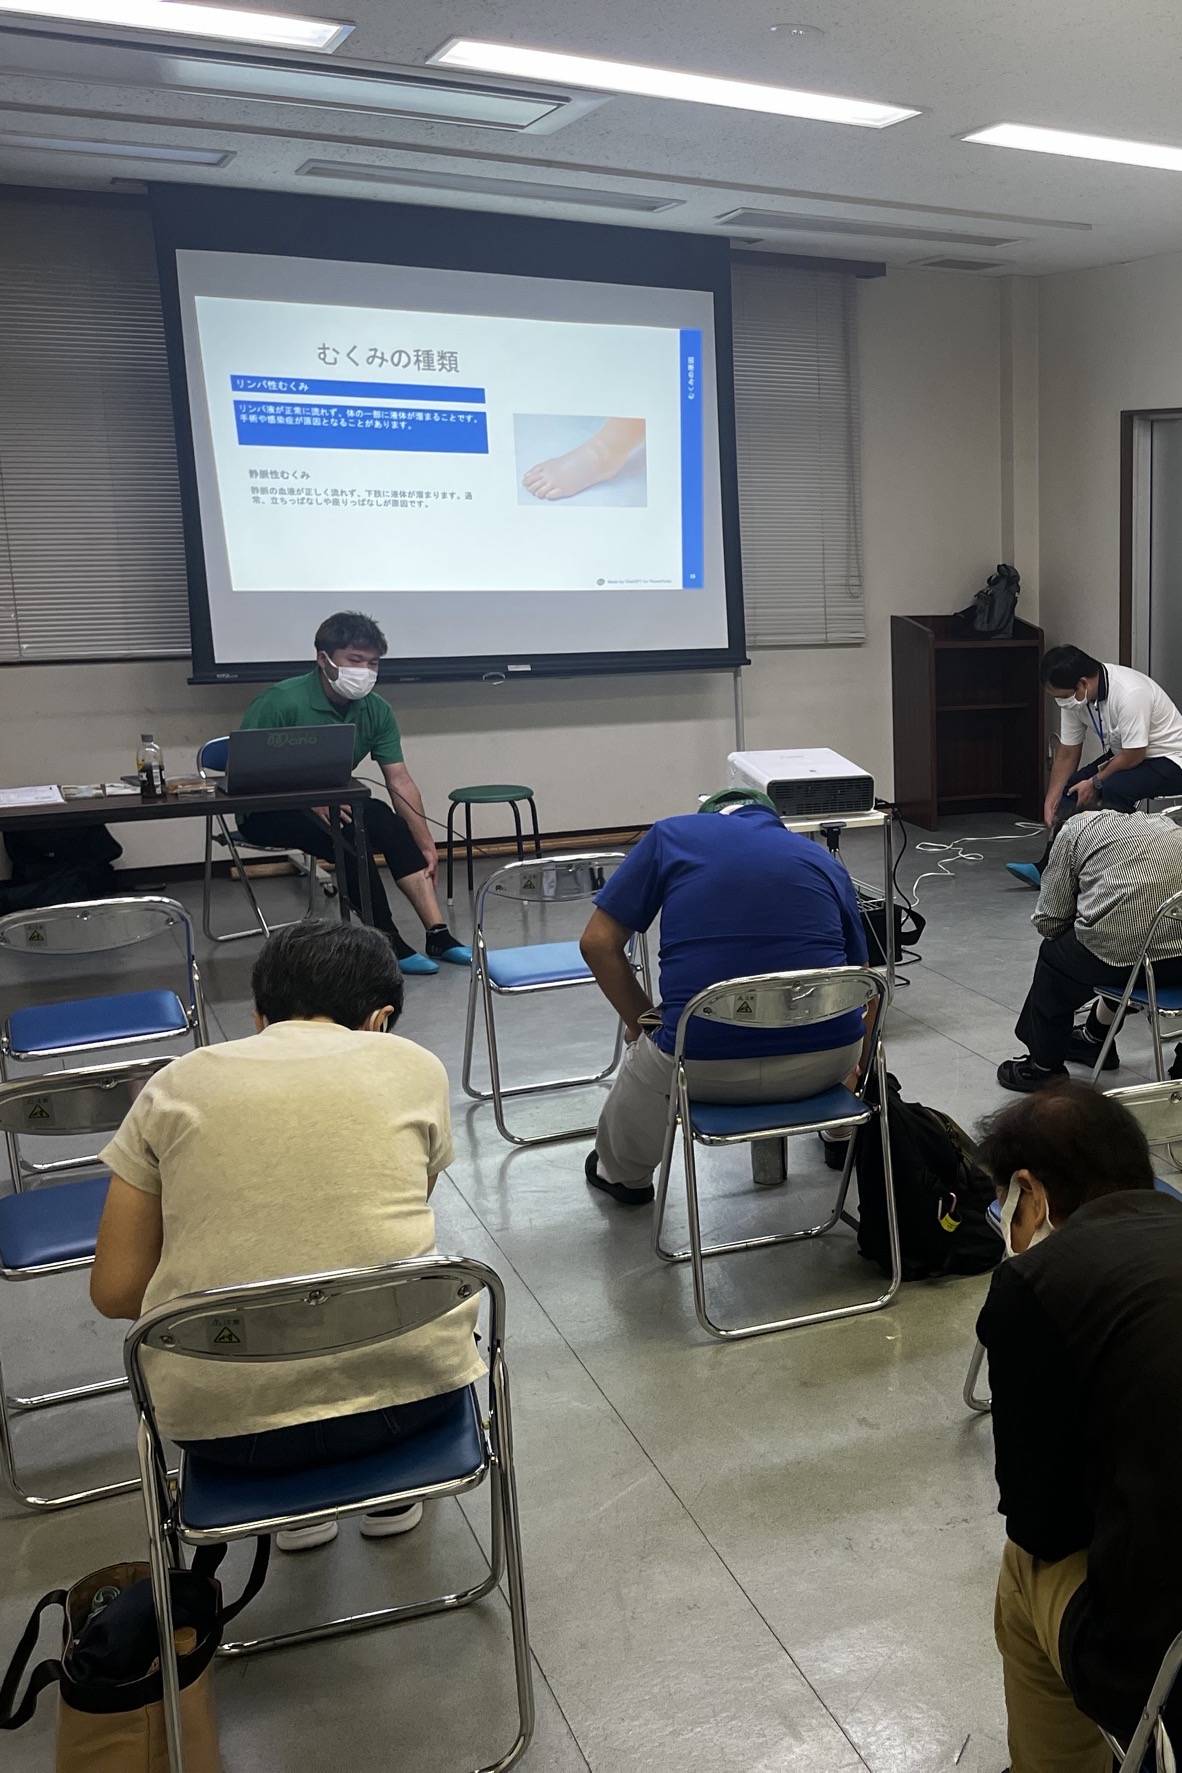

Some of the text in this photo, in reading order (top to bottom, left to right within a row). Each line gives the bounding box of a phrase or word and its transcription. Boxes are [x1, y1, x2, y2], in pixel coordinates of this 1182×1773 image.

[318, 343, 460, 374] むくみの種類
[236, 379, 309, 393] リンパ性むくみ
[248, 469, 311, 481] 静脈性むくみ
